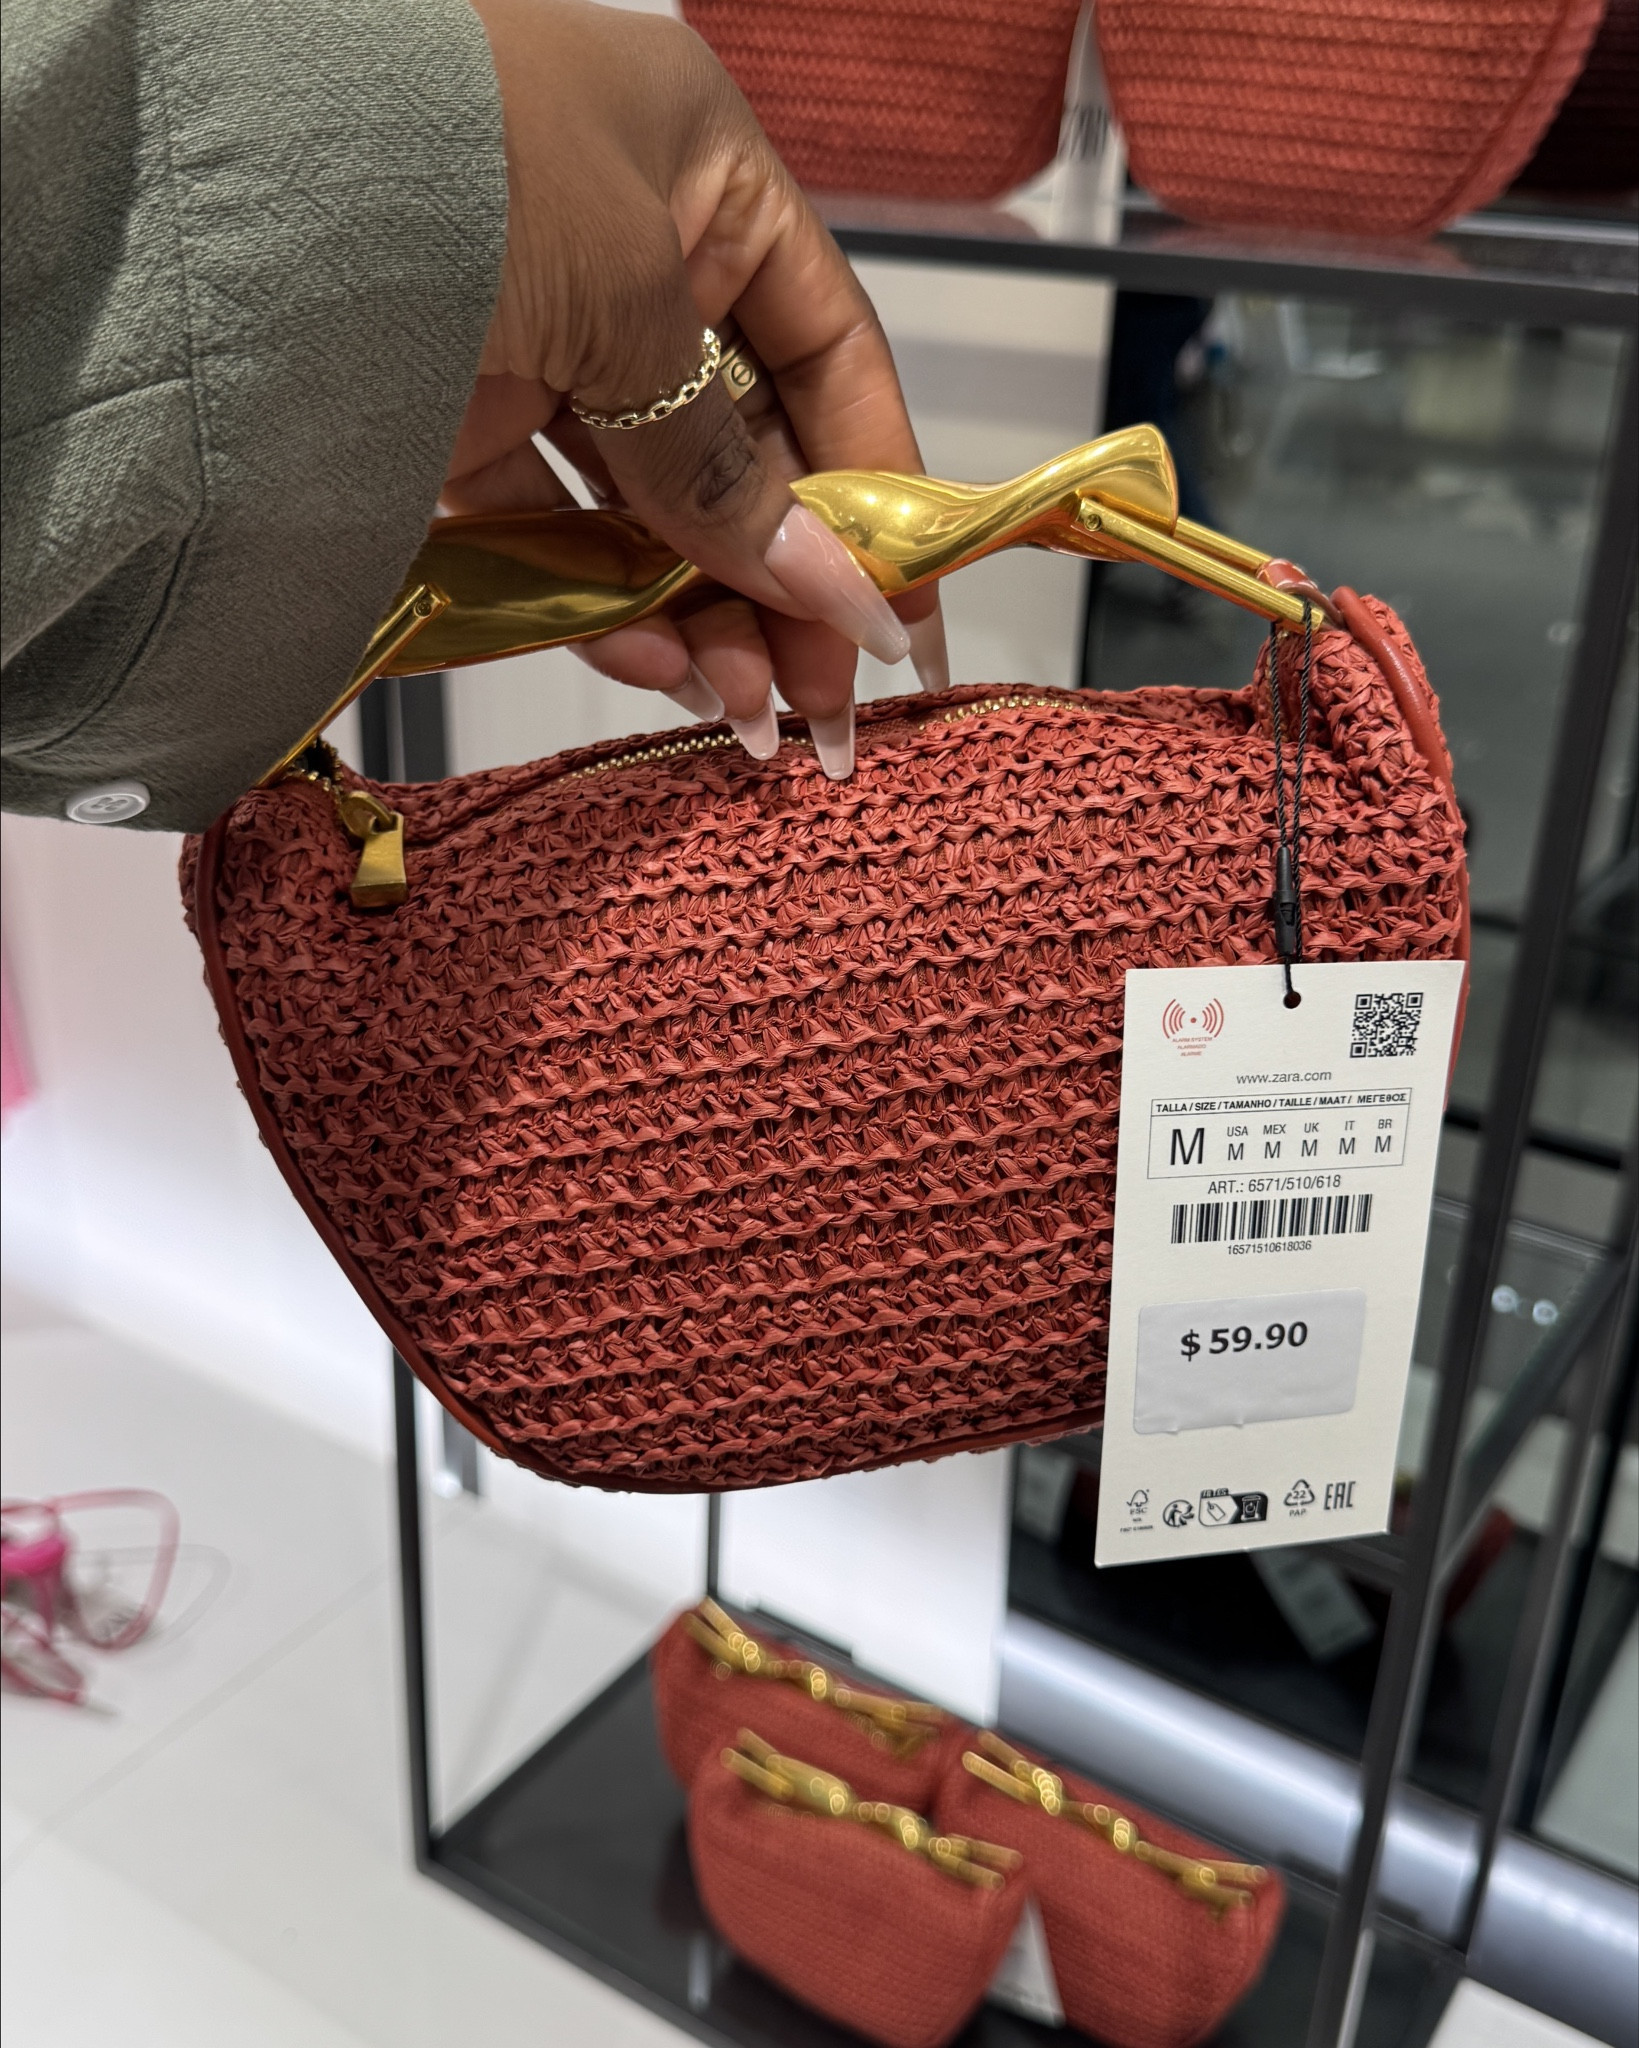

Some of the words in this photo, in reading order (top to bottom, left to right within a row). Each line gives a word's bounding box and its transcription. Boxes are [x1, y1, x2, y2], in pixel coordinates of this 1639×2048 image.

[1236, 1070, 1332, 1084] www.zara.com
[1156, 1103, 1187, 1113] TALLA
[1194, 1101, 1217, 1111] SIZE
[1223, 1099, 1272, 1110] TAMANHO
[1279, 1097, 1312, 1107] TAILLE
[1318, 1095, 1347, 1105] MAAT
[1226, 1126, 1249, 1137] USA
[1263, 1124, 1287, 1135] MEX
[1304, 1122, 1319, 1133] UK
[1344, 1120, 1355, 1131] IT
[1377, 1118, 1392, 1129] BR
[1170, 1127, 1205, 1165] M
[1227, 1142, 1244, 1161] M
[1264, 1141, 1281, 1159] M
[1301, 1139, 1318, 1157] M
[1338, 1137, 1356, 1155] M
[1374, 1135, 1391, 1153] M
[1208, 1179, 1244, 1195] ART.:
[1248, 1174, 1342, 1192] 6571/510/618
[1227, 1240, 1312, 1255] 16571510618036
[1293, 1489, 1306, 1498] 22
[1289, 1509, 1307, 1517] PAP
